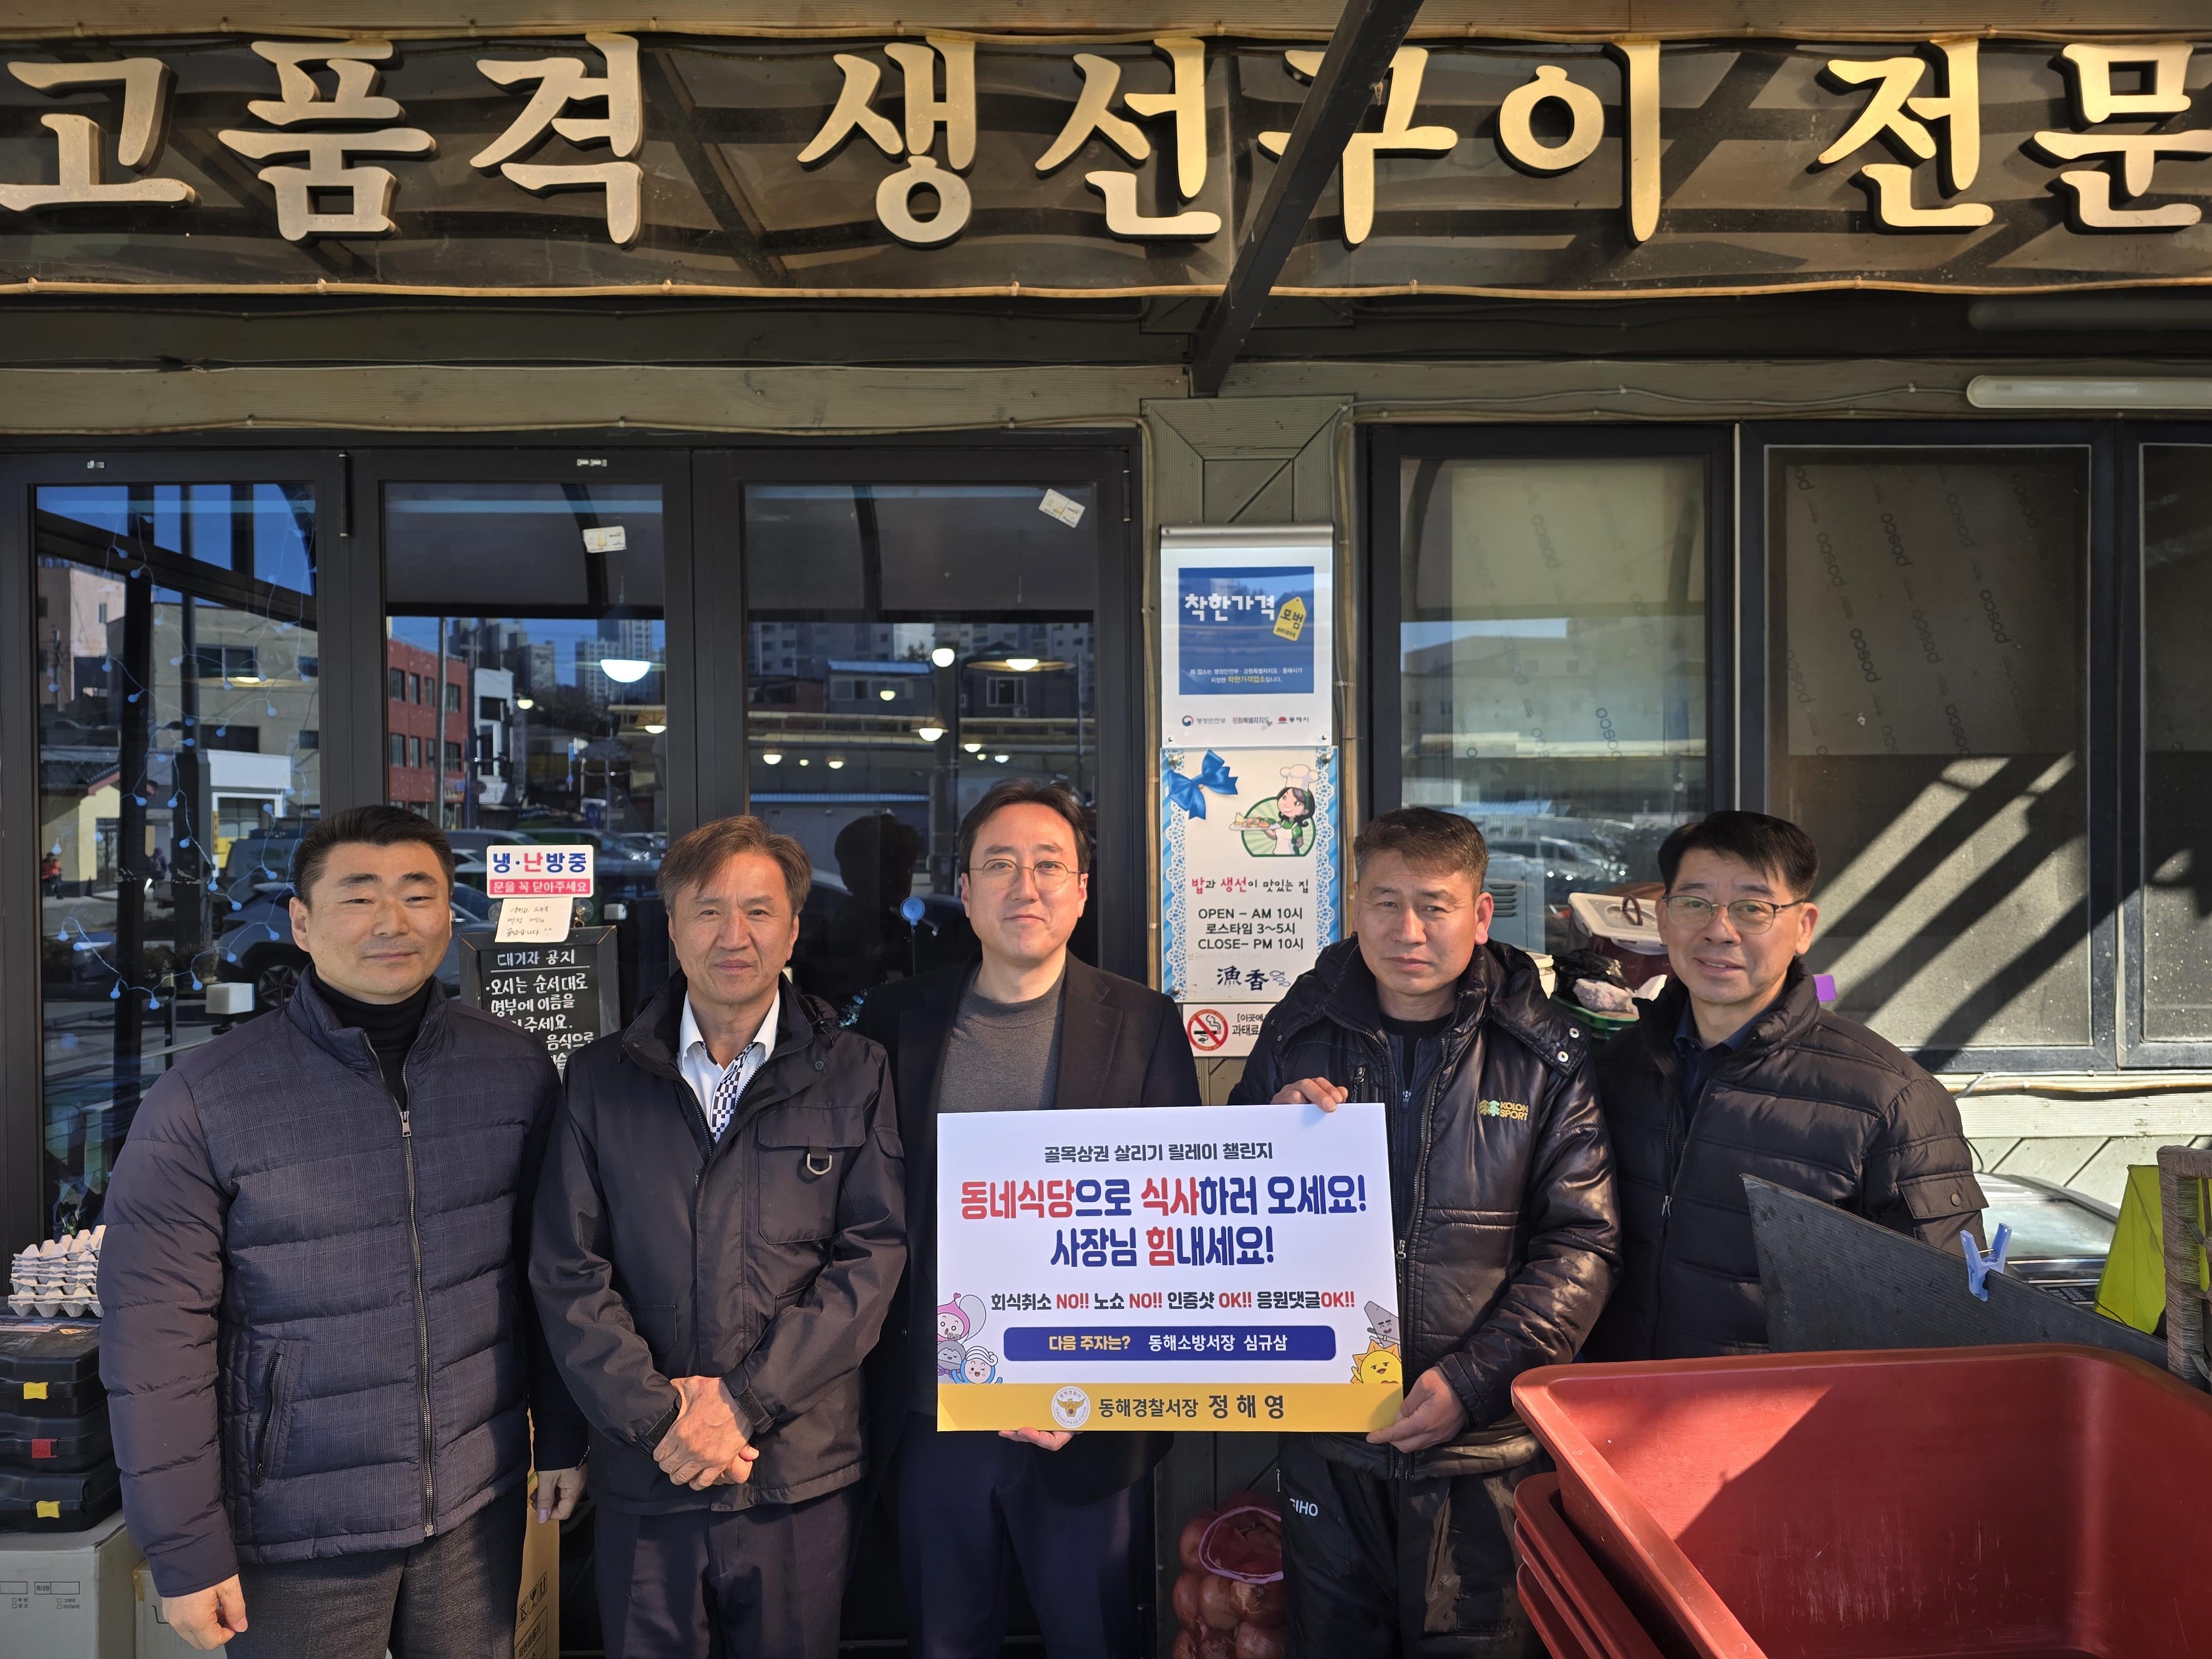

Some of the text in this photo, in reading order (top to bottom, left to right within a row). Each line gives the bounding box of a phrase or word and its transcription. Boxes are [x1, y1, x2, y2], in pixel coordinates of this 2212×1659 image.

[0, 32, 2212, 245] 고품격 생선구이 전문
[1947, 494, 1979, 547] posco
[1532, 514, 1565, 569] posco
[1881, 513, 1913, 567] posco
[1817, 533, 1850, 587] posco
[1185, 593, 1275, 622] 착한가격
[1980, 589, 2012, 643] posco
[1280, 609, 1303, 629] 모범
[1912, 609, 1943, 664] posco
[1850, 628, 1882, 683] posco
[493, 880, 587, 893] 문을 꼭 닫아주세요
[1192, 877, 1308, 894] 밥과 생선이 맛있는 집
[1198, 909, 1234, 919] OPEN
[1251, 909, 1271, 919] AM
[1277, 907, 1302, 920] 10시
[1206, 923, 1252, 935] 로스타임
[1253, 939, 1272, 950] PM
[1278, 938, 1303, 950] 10시
[498, 948, 575, 967] 대기자 공지
[533, 972, 588, 995] 순서대로
[1217, 966, 1269, 991] 漁香
[491, 993, 575, 1018] 명부에 이름을
[1232, 1024, 1260, 1036] 과태료
[1499, 1109, 1528, 1121] SPORT
[1500, 1101, 1528, 1113] KOLON
[1045, 1142, 1272, 1163] 골목상권 살리기 릴레이 챌린지
[961, 1175, 1366, 1219] 동네식당으로 식사하러 오세요!
[1051, 1226, 1274, 1267] 사장님 힘내세요!
[991, 1291, 1354, 1311] 회식취소 NO!! 노쇼 NO!! 인증샷 OK!! 응원댓글OK!!
[1049, 1335, 1287, 1352] 다음 주자는? 동해소방서장 심규삼
[1099, 1399, 1198, 1418] 동해경찰서장
